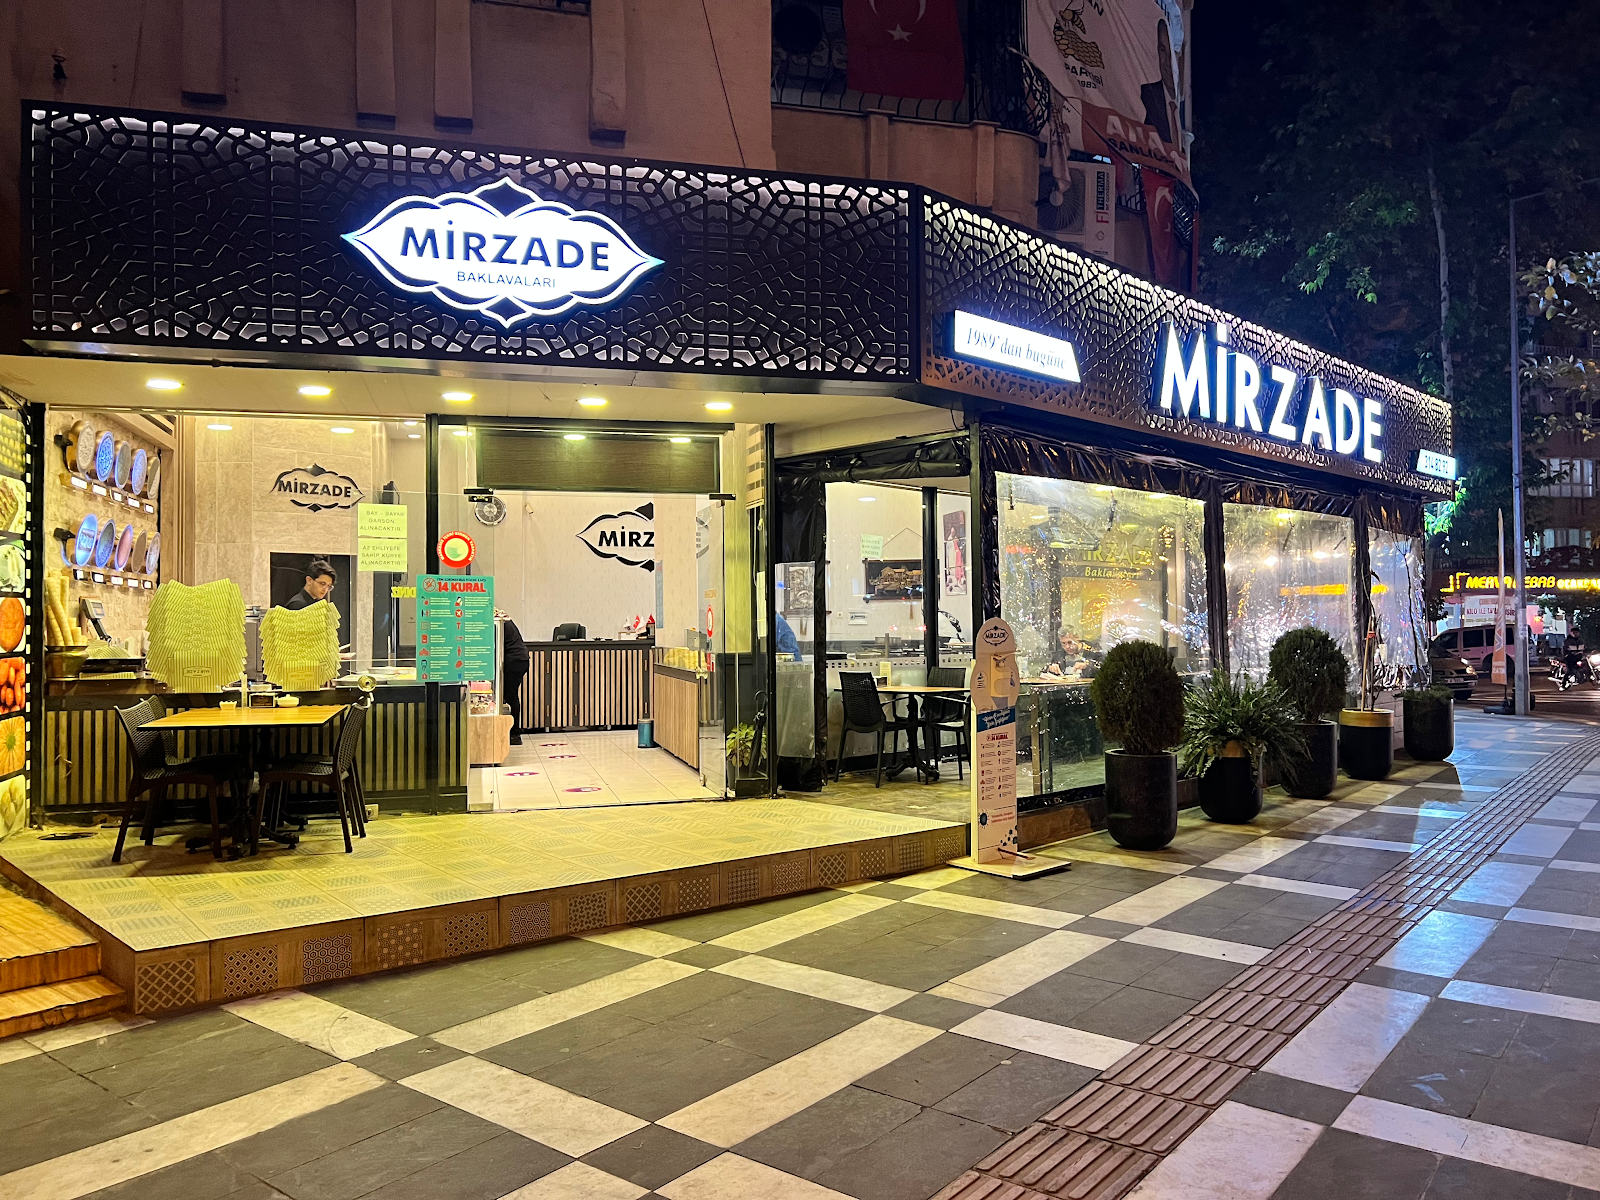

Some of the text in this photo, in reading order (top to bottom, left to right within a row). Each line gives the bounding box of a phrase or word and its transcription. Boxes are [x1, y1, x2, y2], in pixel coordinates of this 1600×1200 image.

[1097, 172, 1105, 209] THERMA
[400, 219, 609, 271] MİRZADE
[457, 270, 556, 288] BAKLAVALARI
[1026, 343, 1066, 369] bugüne
[1159, 319, 1383, 463] MİRZADE
[277, 478, 352, 498] MİRZADE
[437, 581, 486, 593] 14 KURAL
